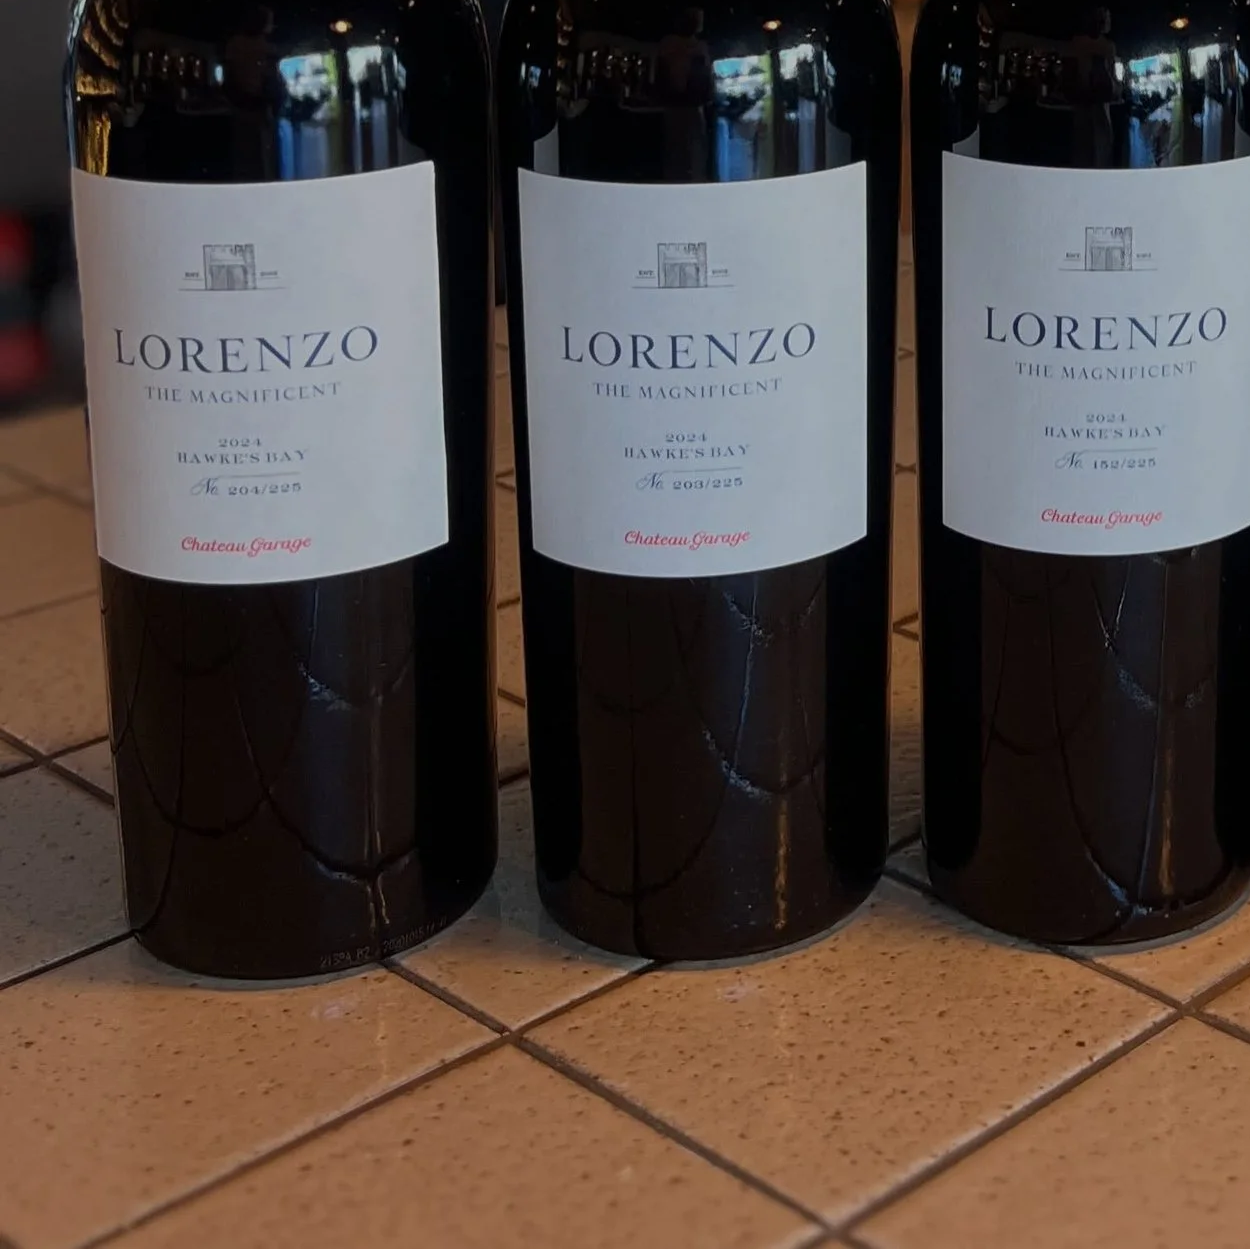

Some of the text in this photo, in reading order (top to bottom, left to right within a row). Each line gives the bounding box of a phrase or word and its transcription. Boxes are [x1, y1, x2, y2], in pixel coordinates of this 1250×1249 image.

[985, 305, 1228, 350] LORENZO
[114, 324, 379, 373] LORENZO
[562, 321, 816, 369] LORENZO
[1014, 360, 1196, 381] THE MAGNIFICENT
[144, 381, 341, 405] THE MAGNIFICENT
[591, 377, 782, 399] THE MAGNIFICENT
[1085, 413, 1128, 424] 2024
[217, 436, 264, 449] 2024
[664, 431, 708, 444] 2024
[1043, 426, 1166, 440] HAWKE'S BAY
[176, 449, 308, 465] HAWKE'S BAY
[623, 444, 751, 461] HAWKE'S BAY
[227, 481, 303, 497] 204/225
[1040, 508, 1163, 530] Chateau Garage
[180, 535, 313, 558] Chateau Garage
[623, 529, 752, 551] Chateau Garage
